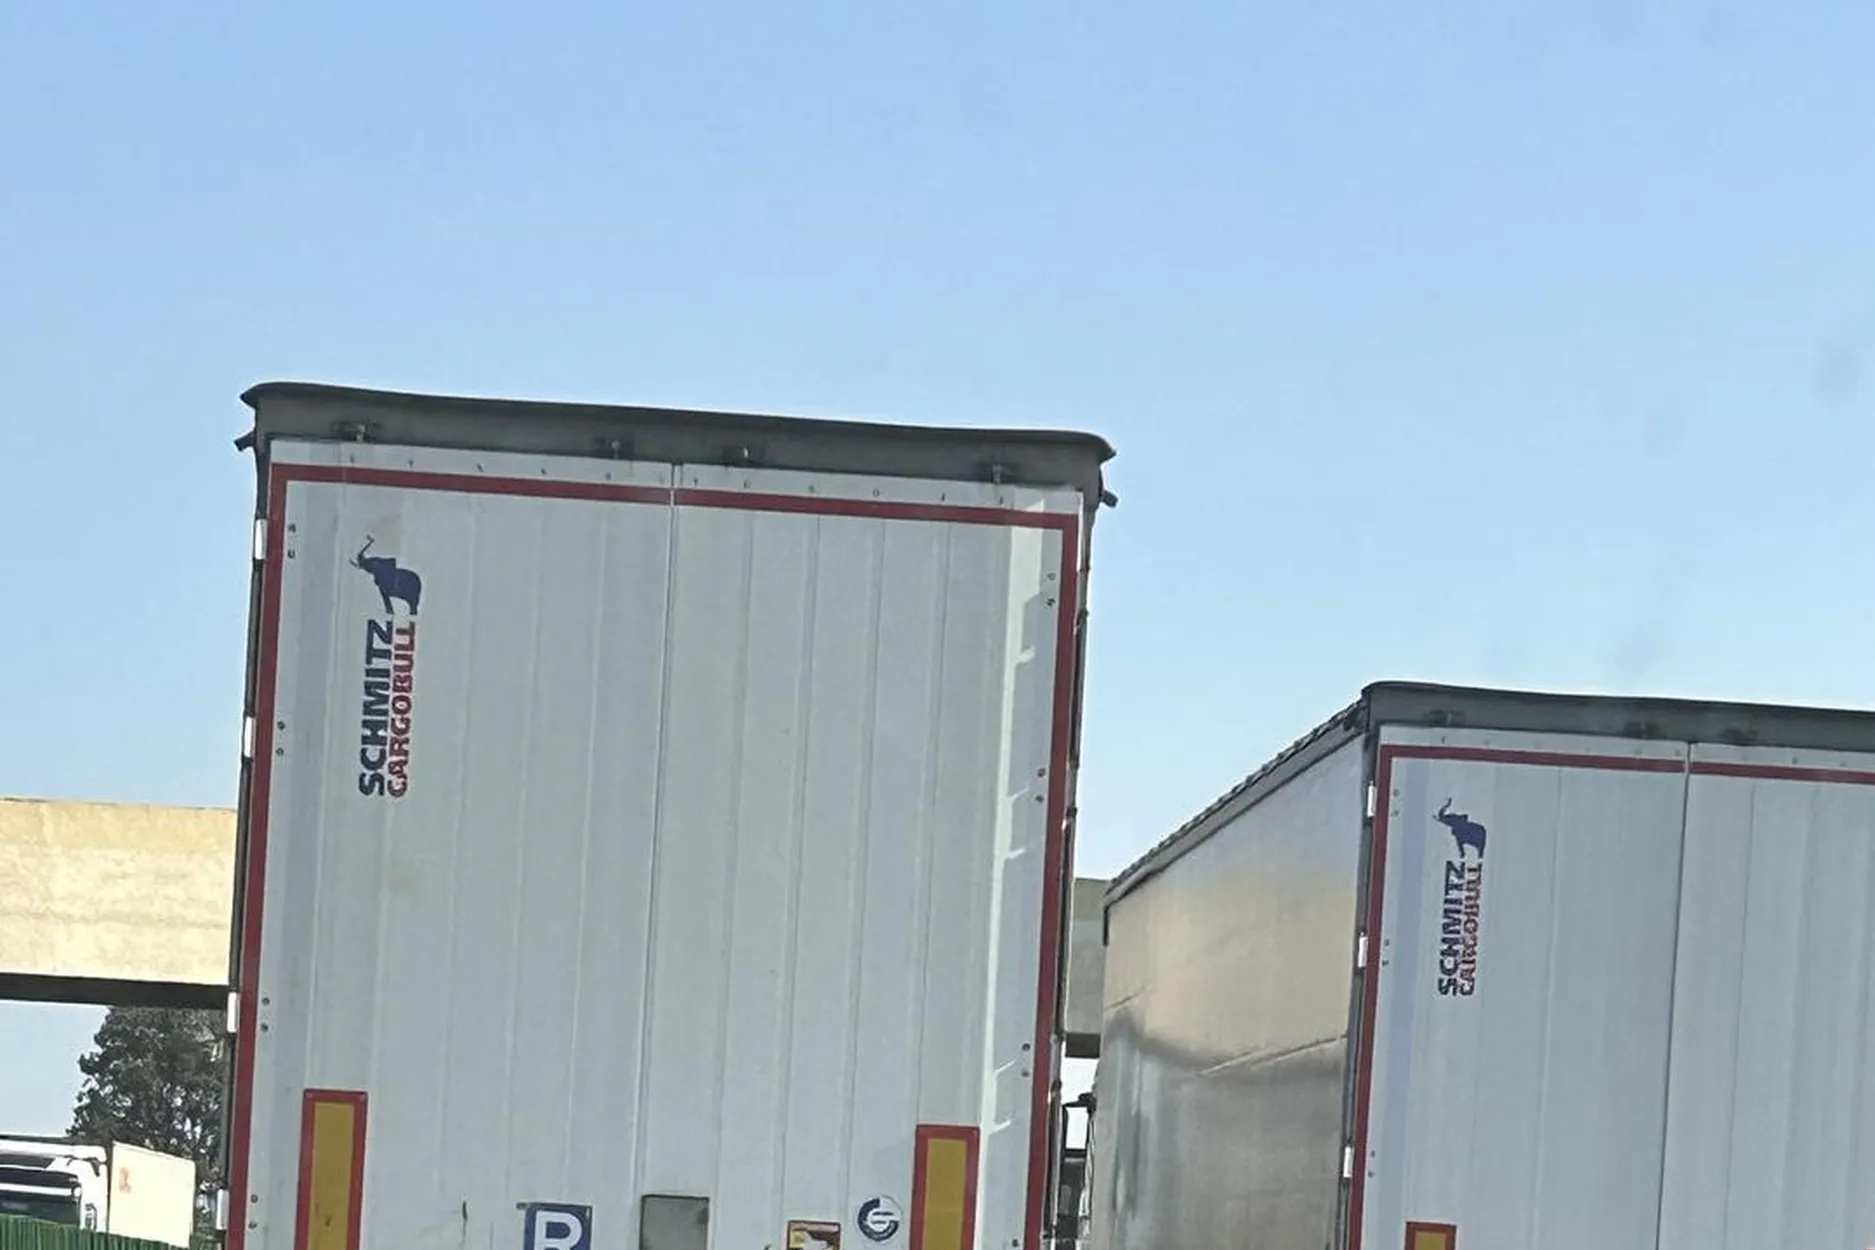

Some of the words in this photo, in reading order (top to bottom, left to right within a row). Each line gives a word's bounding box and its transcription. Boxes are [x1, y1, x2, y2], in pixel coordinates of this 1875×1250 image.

[359, 618, 393, 797] SCHMITZ
[387, 620, 416, 798] CARGOBULL
[1438, 860, 1466, 996] SCHMITZ
